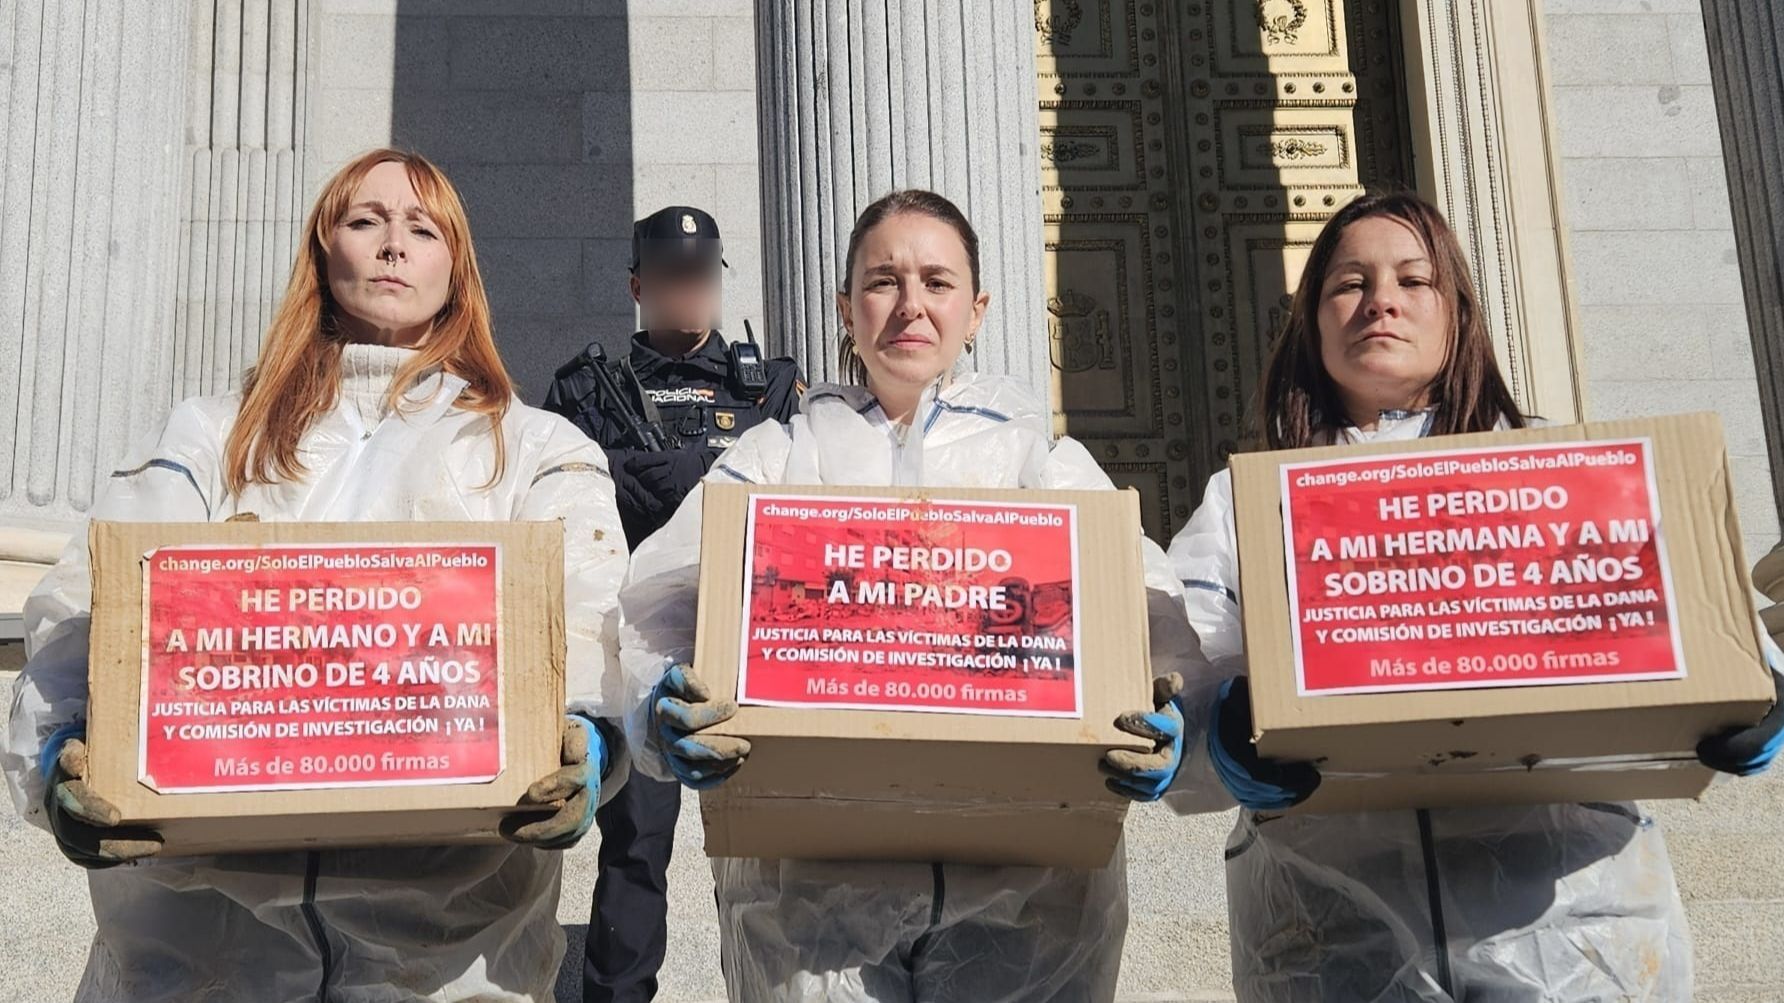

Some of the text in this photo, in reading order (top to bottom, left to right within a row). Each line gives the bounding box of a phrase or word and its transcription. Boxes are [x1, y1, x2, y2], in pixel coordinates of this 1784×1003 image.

[1296, 450, 1636, 488] change.org/SoloElPuebloSalvaAlPueblo
[1379, 486, 1568, 521] HE PERDIDO
[1311, 519, 1648, 561] A MI HERMANA Y A MI
[159, 554, 487, 573] change.org/SoloElPuebloSalvaAlPueblo
[824, 545, 1011, 572] HE PERDIDO
[1324, 553, 1643, 597] SOBRINO DE 4 AÑOS
[241, 586, 421, 612] HE PERDIDO
[828, 581, 1006, 610] A MI PADRE
[1303, 589, 1658, 623] JUSTICIA PARA LAS VÍCTIMAS DE LA DANA
[166, 623, 491, 652] A MI HERMANO Y A MI
[752, 628, 1066, 650] JUSTICIA PARA LAS VÍCTIMAS DE LA DANA
[1316, 629, 1328, 643] Y
[1332, 622, 1422, 643] COMISIÓN
[1428, 624, 1452, 639] DE
[1456, 614, 1600, 638] INVESTIGACIÓN
[762, 648, 774, 660] Y
[776, 646, 858, 664] COMISIÓN
[864, 652, 884, 665] DE
[889, 652, 1016, 669] INVESTIGACIÓN
[1370, 648, 1620, 678] Más de 80.000 firmas
[178, 656, 481, 691] SOBRINO DE 4 AÑOS
[807, 677, 1027, 702] Más de 80.000 firmas
[152, 694, 490, 717] JUSTICIA PARA LAS VÍCTIMAS DE LA DANA
[163, 727, 176, 740] Y
[179, 721, 270, 740] COMISIÓN
[276, 723, 299, 738] DE
[303, 717, 438, 737] INVESTIGACIÓN
[214, 752, 450, 777] Más de 80.000 firmas
